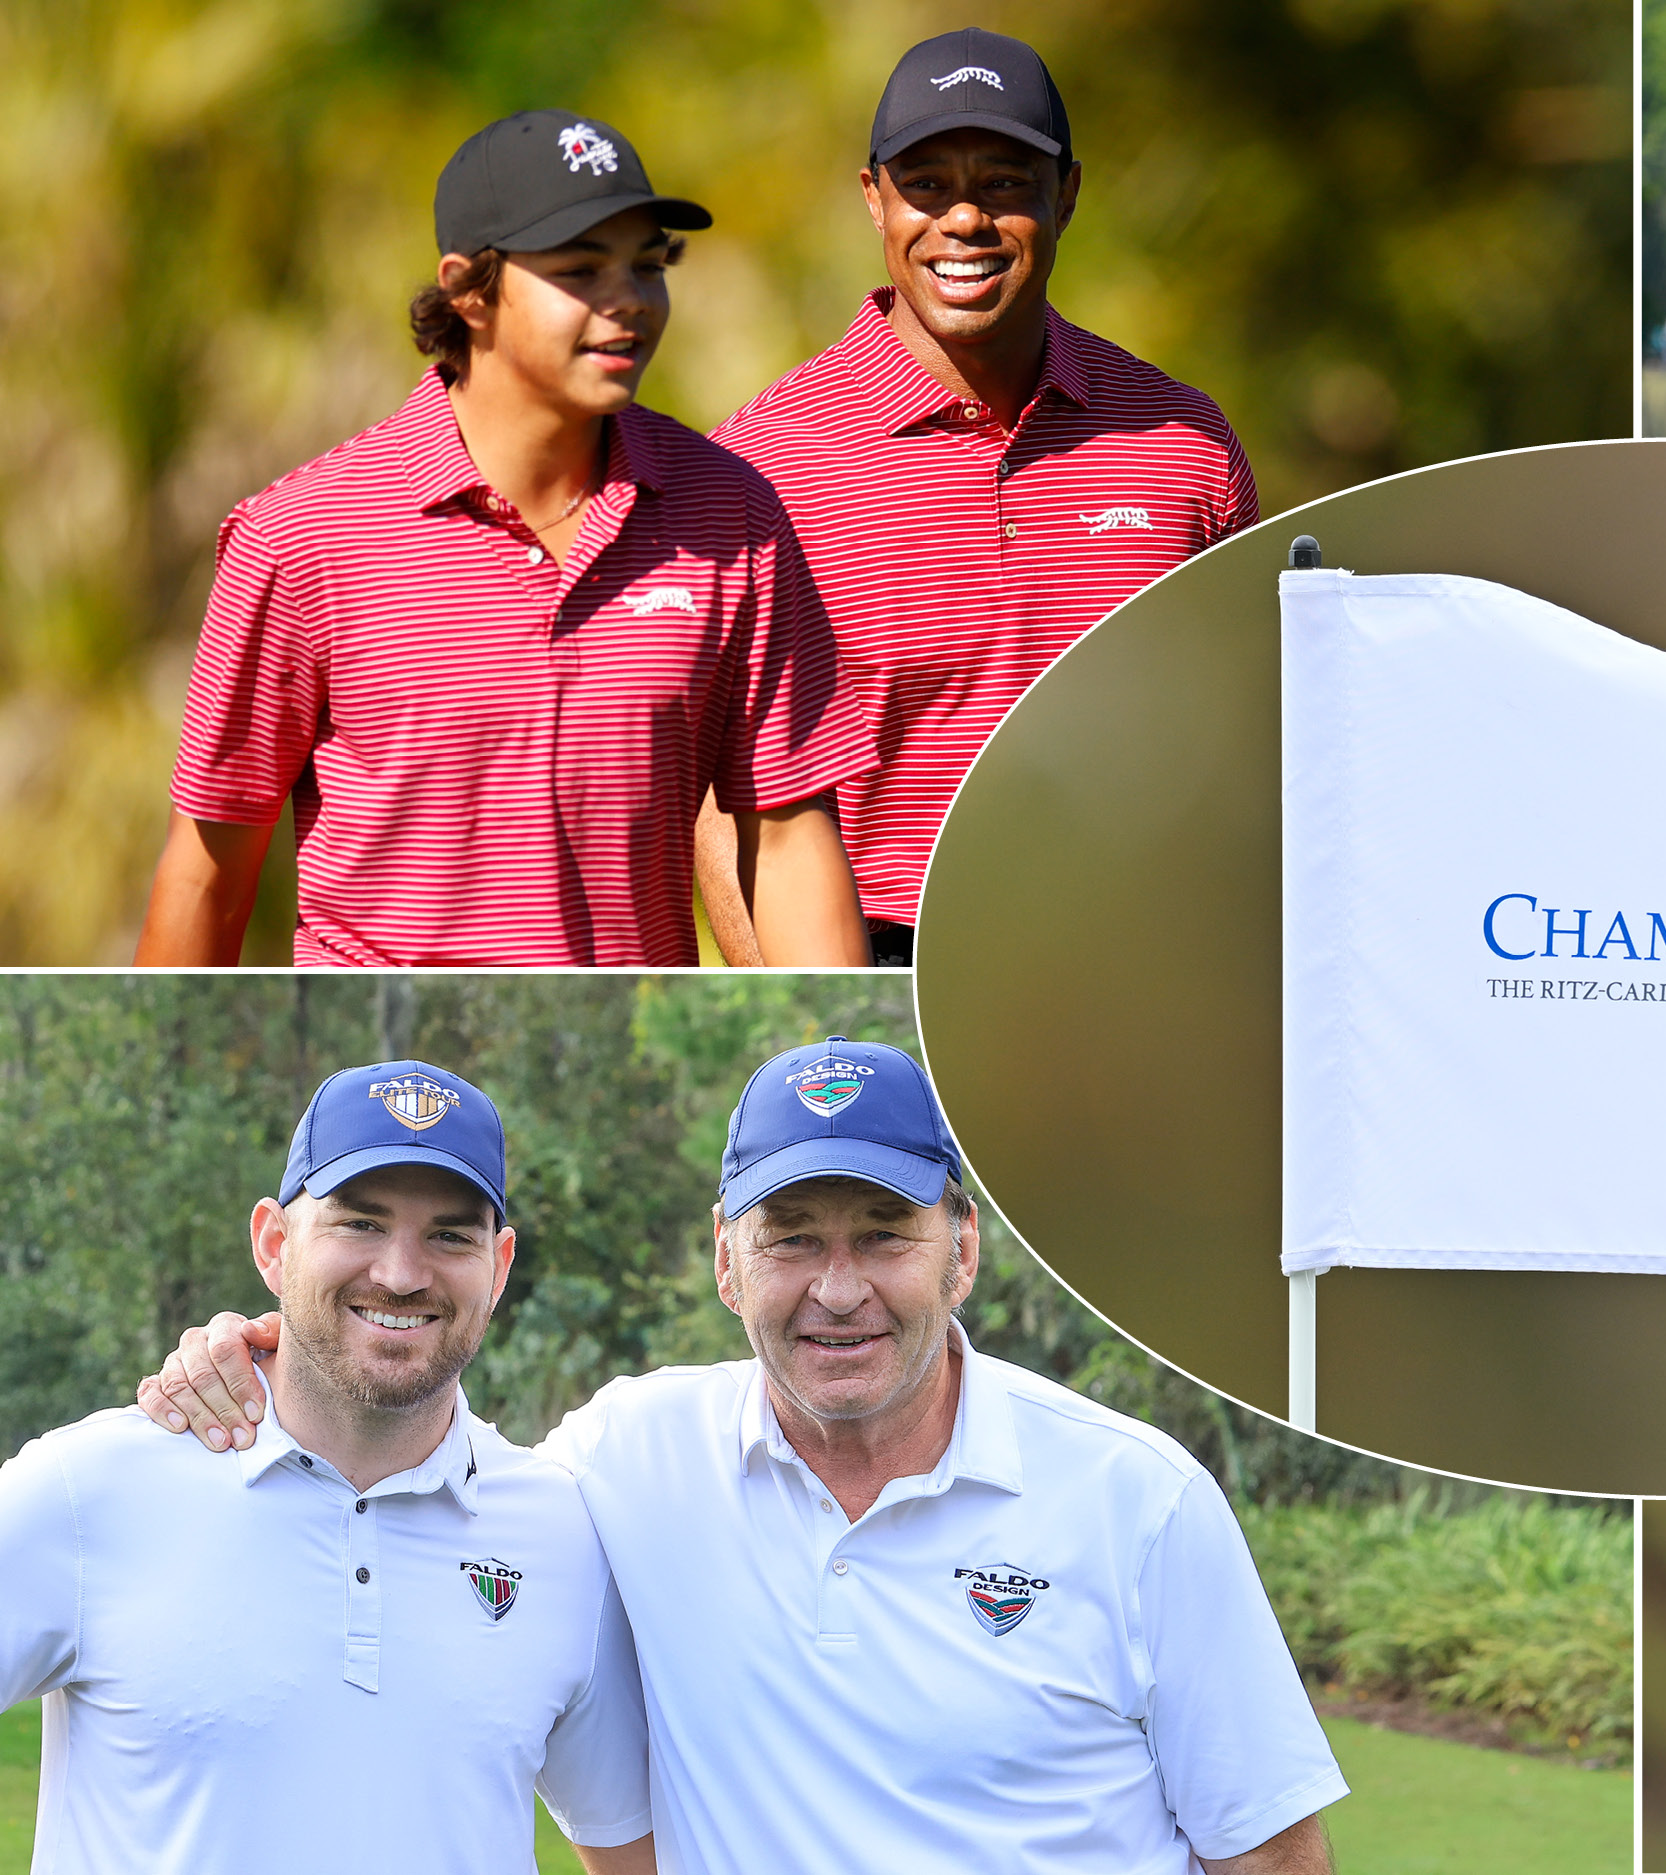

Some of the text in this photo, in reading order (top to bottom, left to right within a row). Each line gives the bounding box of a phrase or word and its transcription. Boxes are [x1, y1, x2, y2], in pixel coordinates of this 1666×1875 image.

[1486, 978, 1535, 1000] THE
[784, 1062, 876, 1086] FALDO
[801, 1071, 859, 1086] DESIGN
[368, 1086, 462, 1109] ELITE TOUR
[369, 1079, 461, 1101] FALDO
[459, 1561, 524, 1581] FALDO
[953, 1567, 1051, 1591] FALDO
[972, 1581, 1030, 1597] DESIGN
